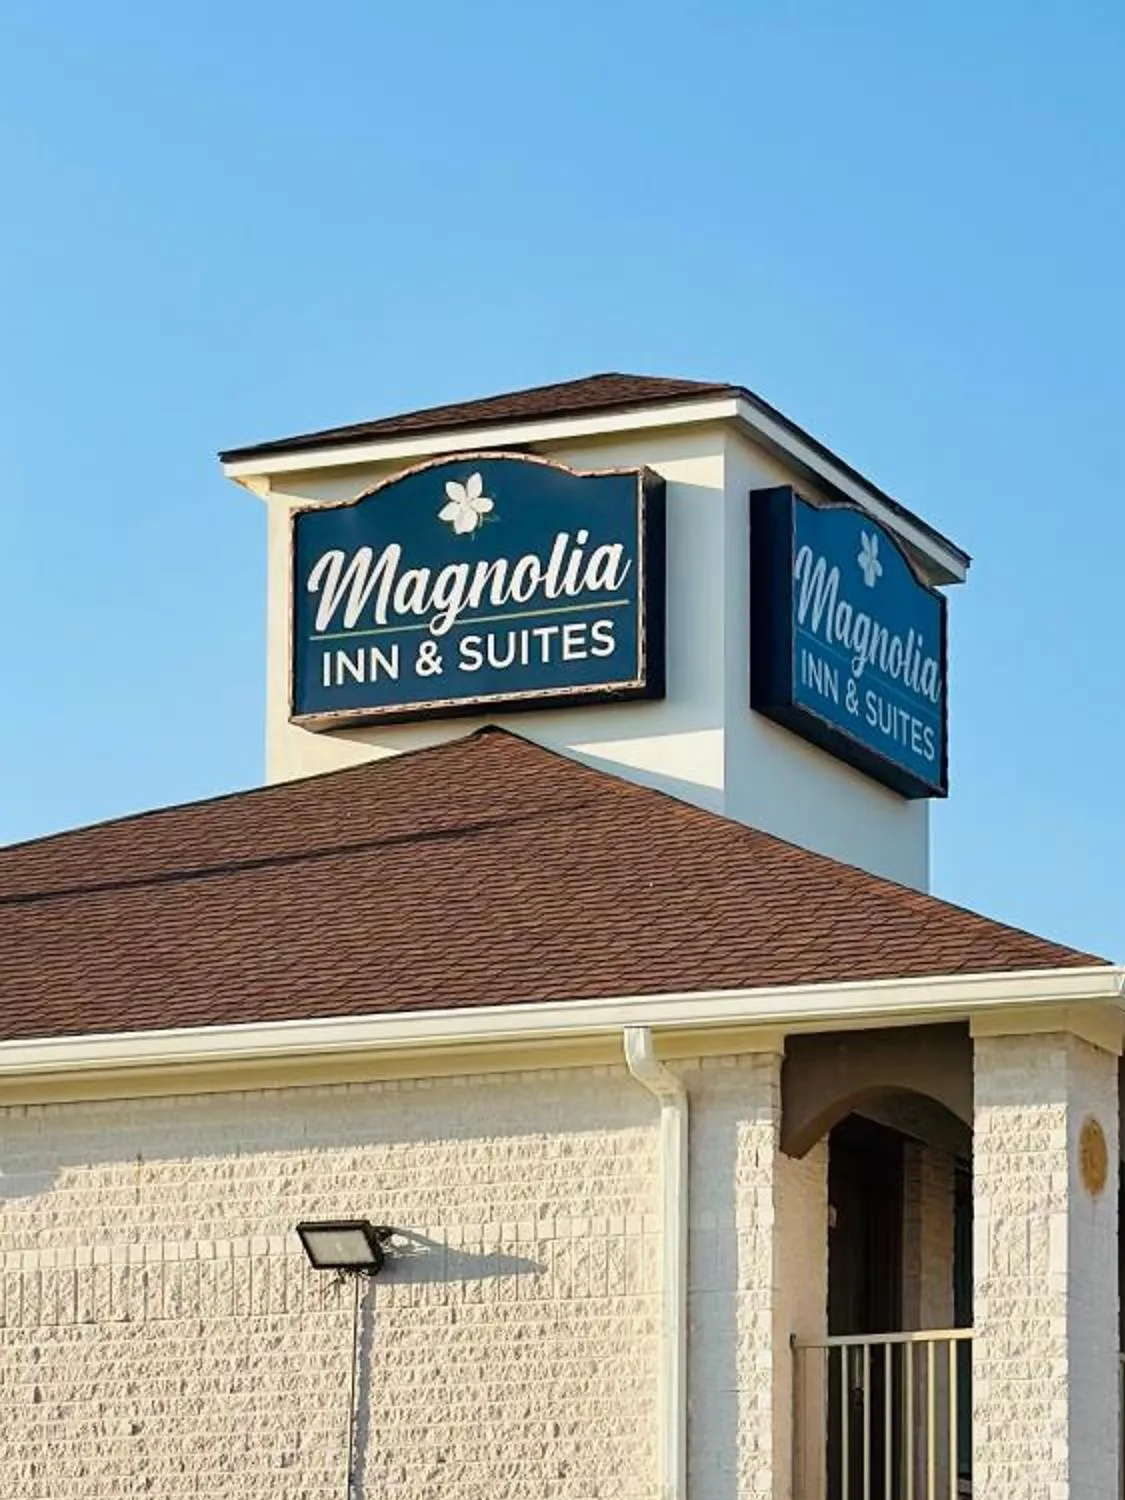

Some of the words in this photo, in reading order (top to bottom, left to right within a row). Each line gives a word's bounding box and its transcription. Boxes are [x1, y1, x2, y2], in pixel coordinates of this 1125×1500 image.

[306, 529, 632, 636] Magnolia
[794, 545, 942, 704] Magnolia
[322, 644, 399, 687] INN
[414, 640, 443, 677] &
[458, 620, 616, 673] SUITES
[801, 648, 839, 705] INN
[845, 678, 860, 717] &
[865, 692, 935, 762] SUITES
